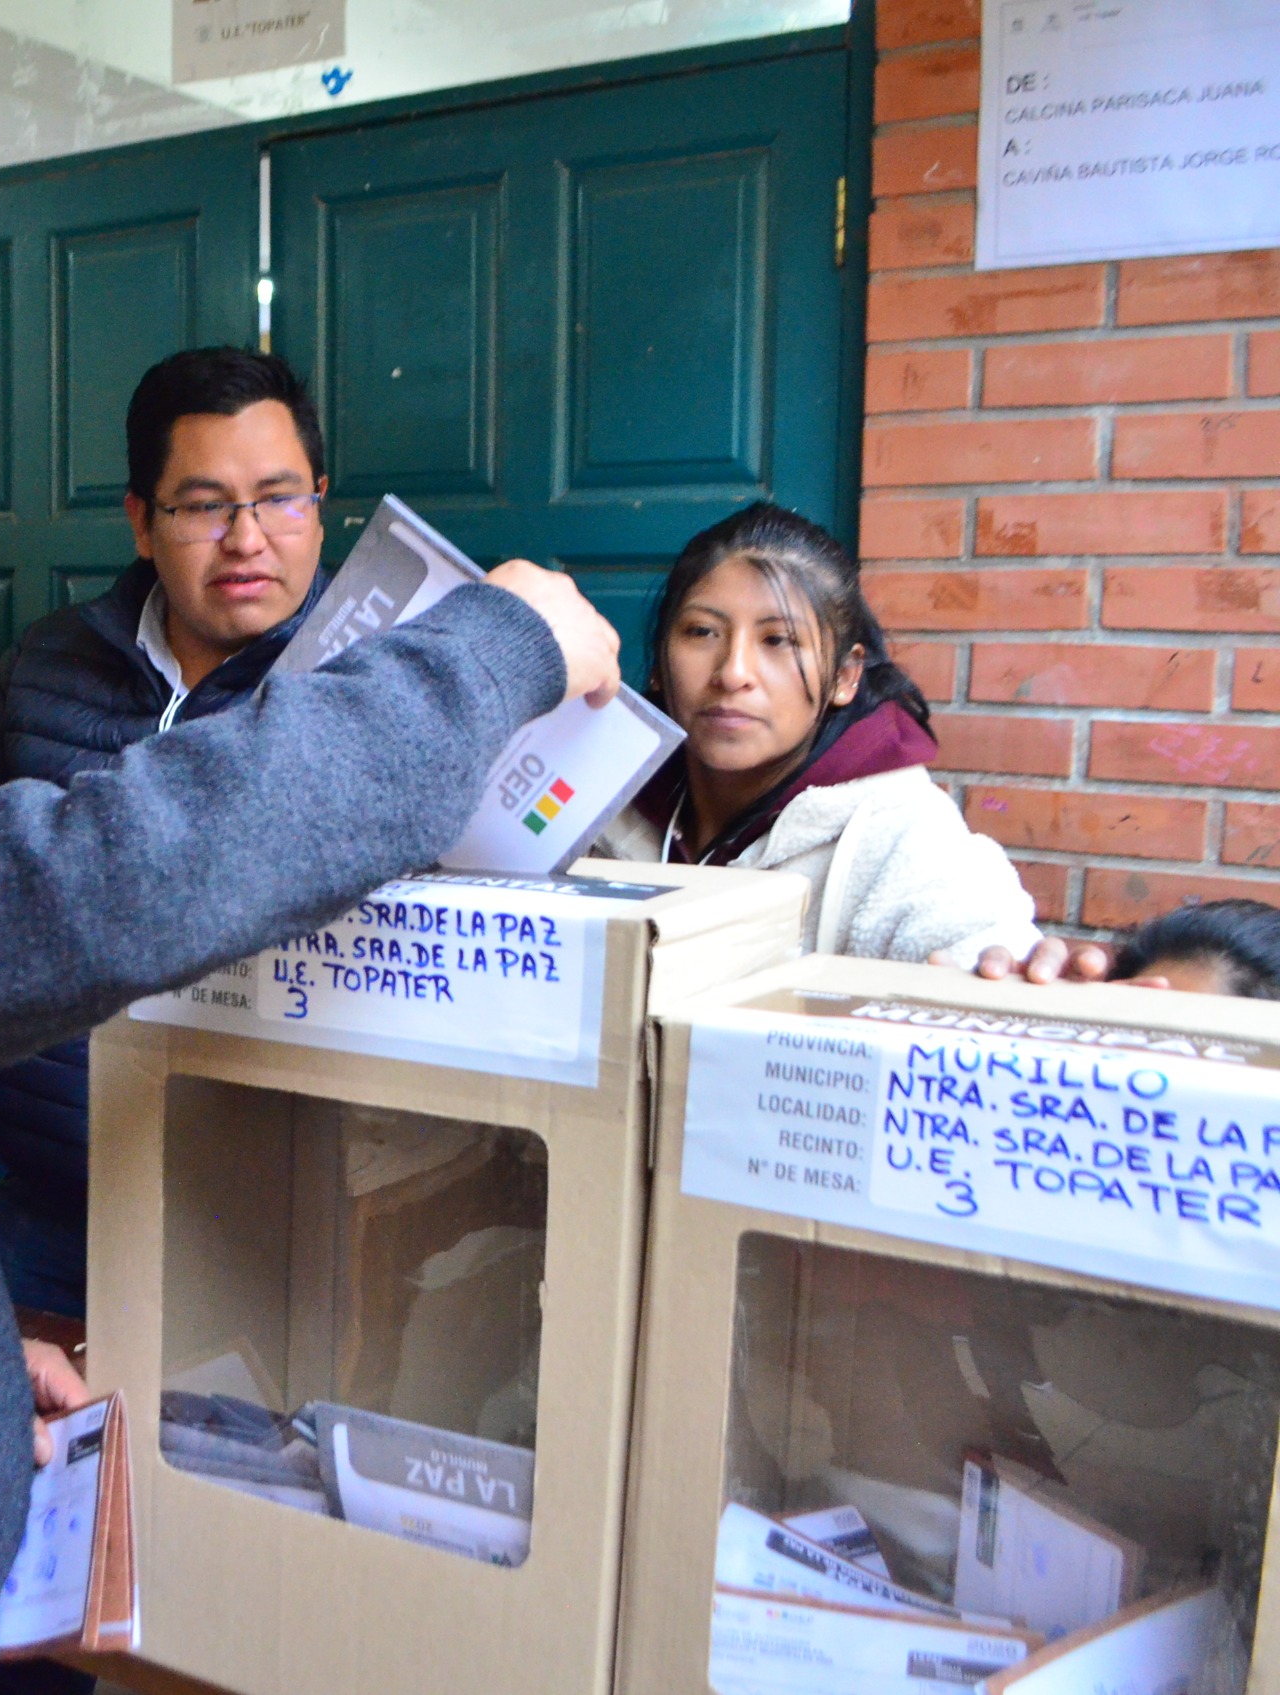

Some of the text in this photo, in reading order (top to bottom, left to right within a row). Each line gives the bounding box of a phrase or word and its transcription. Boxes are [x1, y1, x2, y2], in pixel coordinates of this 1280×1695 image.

[1197, 77, 1265, 103] JUANA
[1077, 154, 1173, 180] BAUTISTA
[1178, 146, 1248, 170] JORGE
[498, 753, 546, 812] OEP
[456, 909, 486, 937] LA
[493, 912, 562, 946] PAZ
[274, 958, 314, 987] U.E.
[322, 961, 454, 1003] TOPATER
[457, 947, 488, 973] LA
[495, 947, 561, 982] PAZ
[191, 986, 208, 1003] DE
[211, 989, 252, 1010] MESA:
[284, 986, 309, 1018] 3
[766, 1028, 873, 1060] PROVINCIA:
[850, 1003, 1248, 1064] MUNICIPAL
[765, 1060, 870, 1094] MUNICIPIO:
[907, 1043, 1168, 1100] MURILLO
[757, 1092, 867, 1128] LOCALIDAD:
[887, 1070, 997, 1112] NTRA.
[1009, 1091, 1108, 1131] SRA.
[1122, 1106, 1179, 1142] DE
[1197, 1117, 1248, 1152] LA
[778, 1128, 864, 1161] RECINTO:
[884, 1107, 979, 1147] NTRA.
[1166, 1152, 1215, 1184] LA
[773, 1161, 798, 1183] DE
[803, 1166, 861, 1194] MESA:
[886, 1144, 1262, 1228] U.E. TOPATER
[935, 1179, 979, 1217] 3
[404, 1455, 517, 1510] LA PAZ
